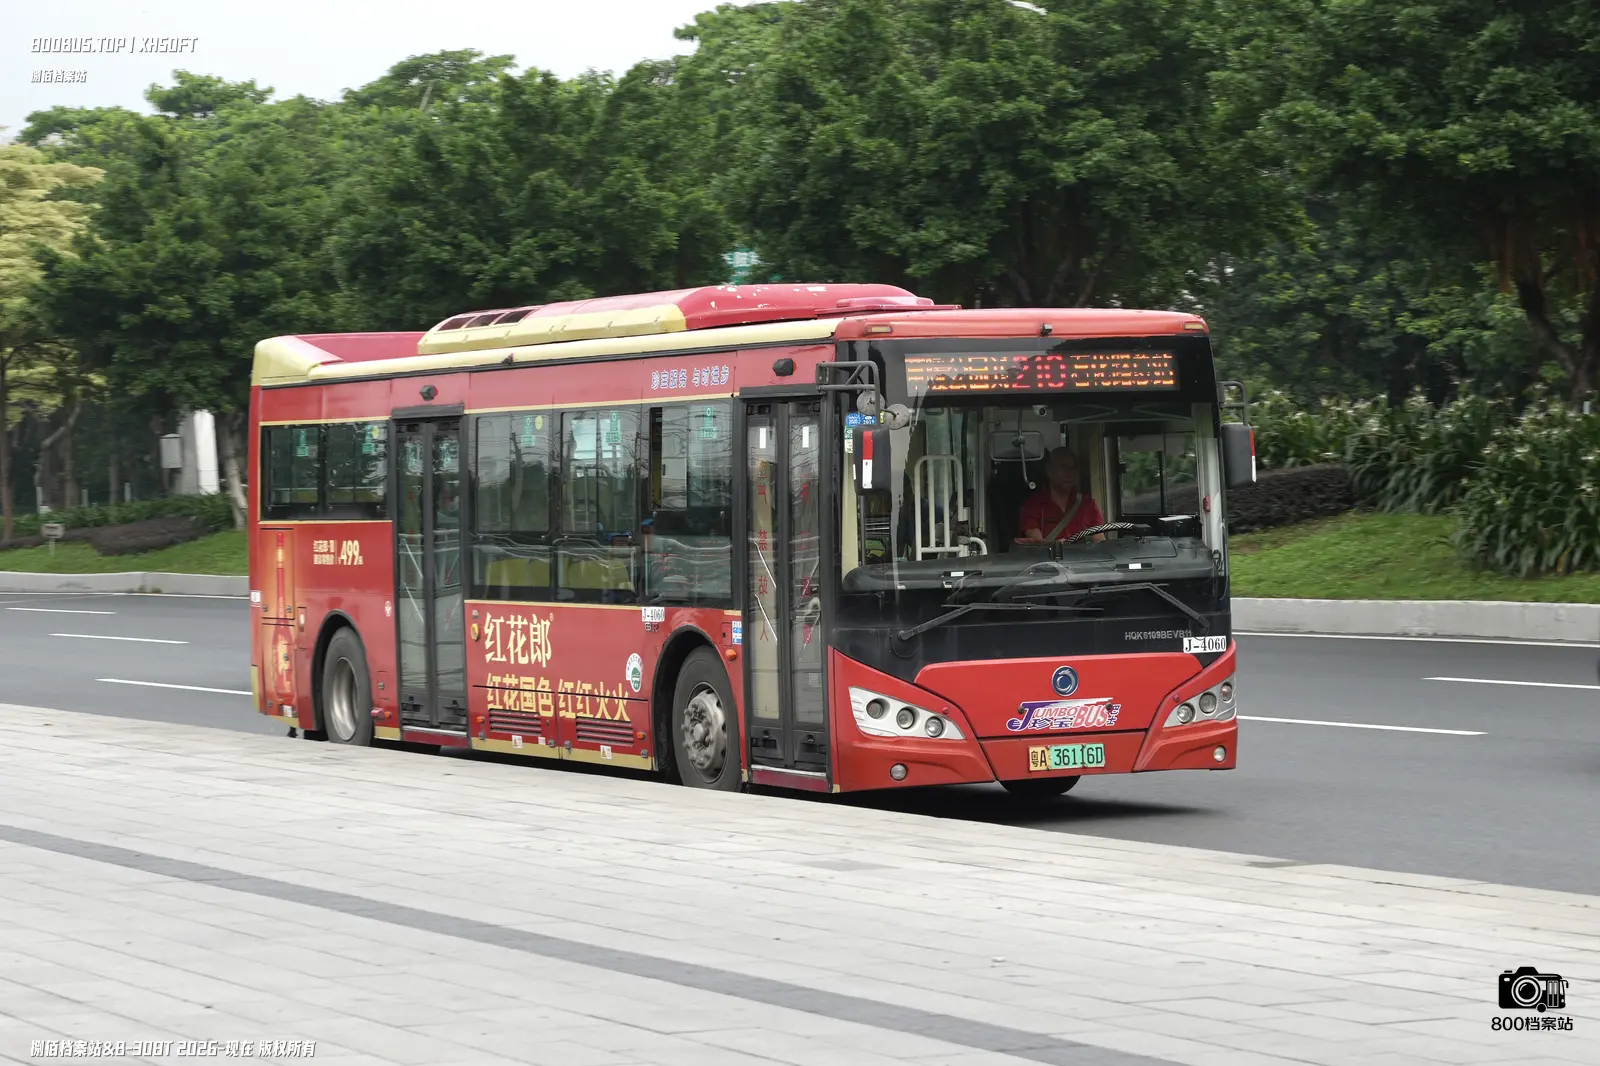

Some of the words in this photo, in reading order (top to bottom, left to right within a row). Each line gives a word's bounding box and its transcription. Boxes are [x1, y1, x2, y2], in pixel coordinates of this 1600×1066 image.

[484, 612, 552, 668] 红花郎
[1185, 637, 1226, 653] J-4060
[486, 673, 554, 717] 红花国色
[558, 678, 632, 722] 红红火火
